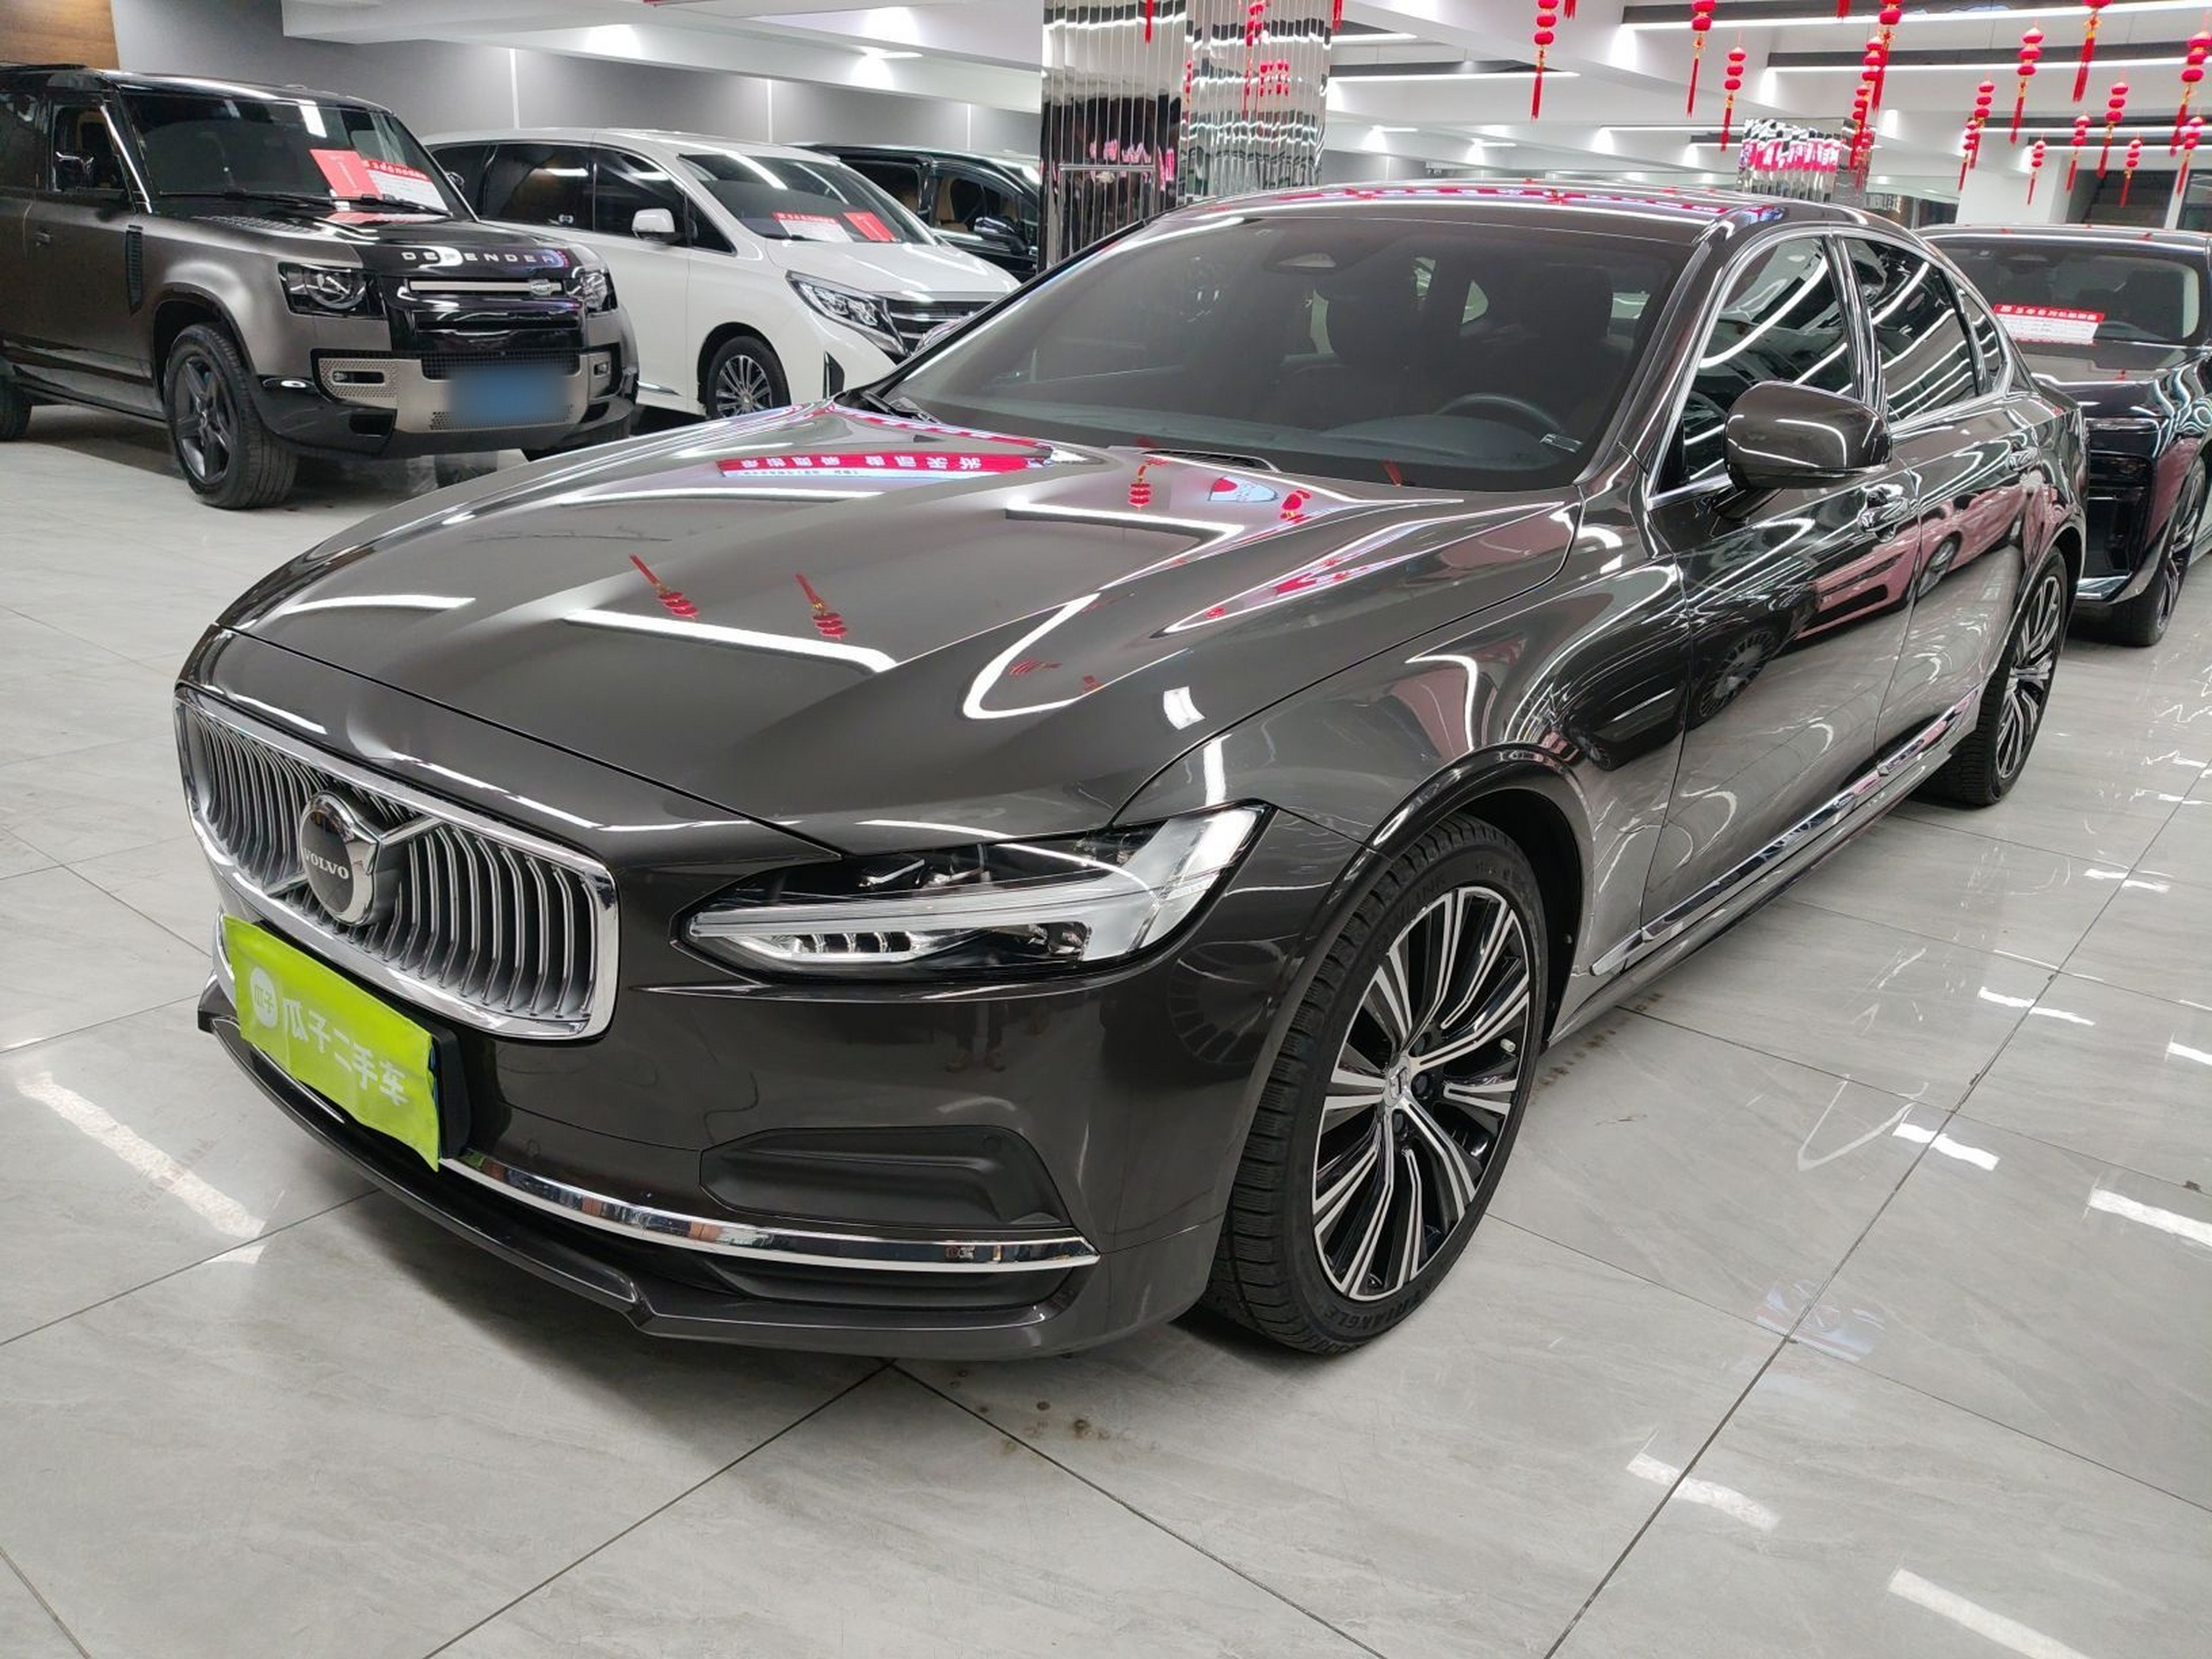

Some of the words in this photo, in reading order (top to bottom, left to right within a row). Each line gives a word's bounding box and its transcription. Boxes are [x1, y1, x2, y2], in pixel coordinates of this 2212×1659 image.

[401, 252, 555, 263] DEFENDER
[304, 847, 349, 880] VOLVO
[282, 997, 409, 1107] 瓜子二手车
